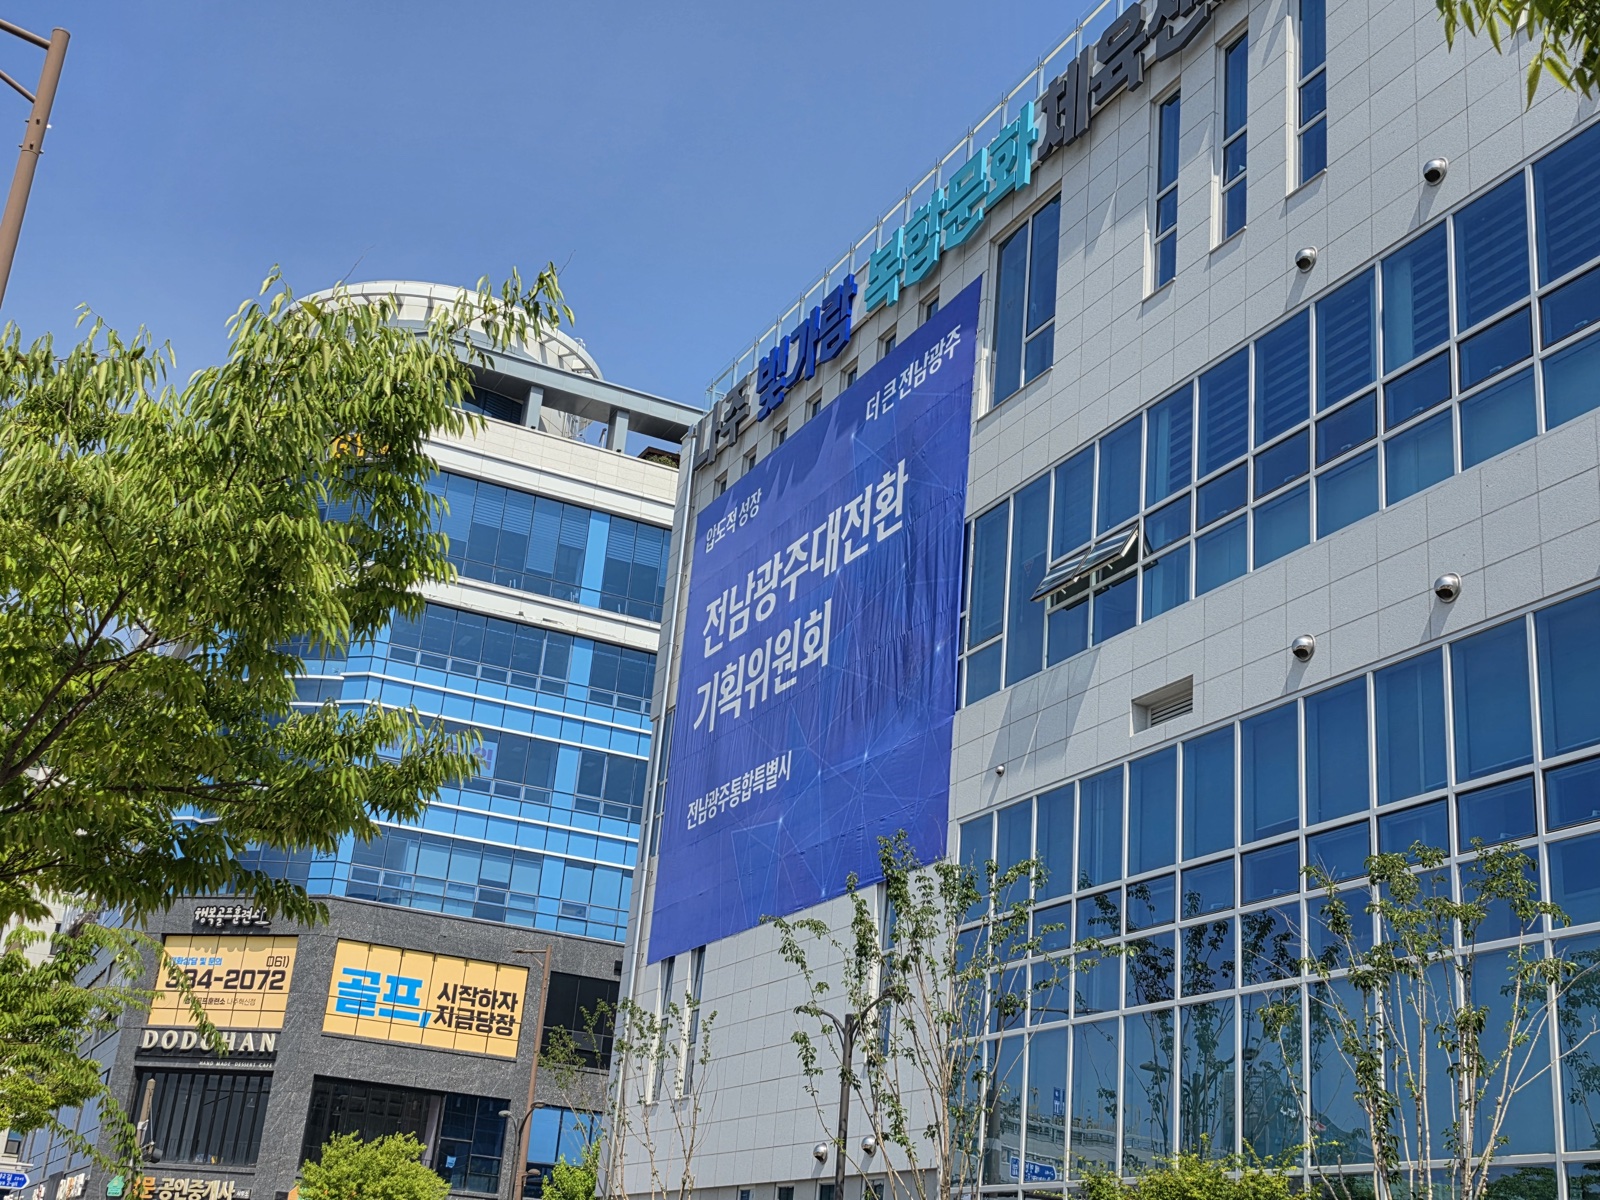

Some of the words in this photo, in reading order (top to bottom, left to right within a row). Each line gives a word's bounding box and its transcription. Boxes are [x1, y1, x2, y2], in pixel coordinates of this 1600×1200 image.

[693, 372, 750, 471] 나주
[756, 274, 858, 422] 빛가람
[864, 101, 1038, 312] 복합문화
[865, 397, 880, 422] 더
[881, 380, 897, 415] 큰
[899, 324, 962, 400] 전남광주
[705, 508, 738, 554] 압도적
[738, 488, 762, 528] 성장
[703, 458, 909, 659] 전남광주대전환
[693, 598, 833, 733] 기획위원회
[686, 750, 792, 831] 전남광주통합특별시
[195, 905, 260, 927] 행복골프훈련소
[433, 1004, 516, 1037] 지금당장
[437, 982, 519, 1013] 시작하자
[158, 1177, 236, 1200] 공인중개사
